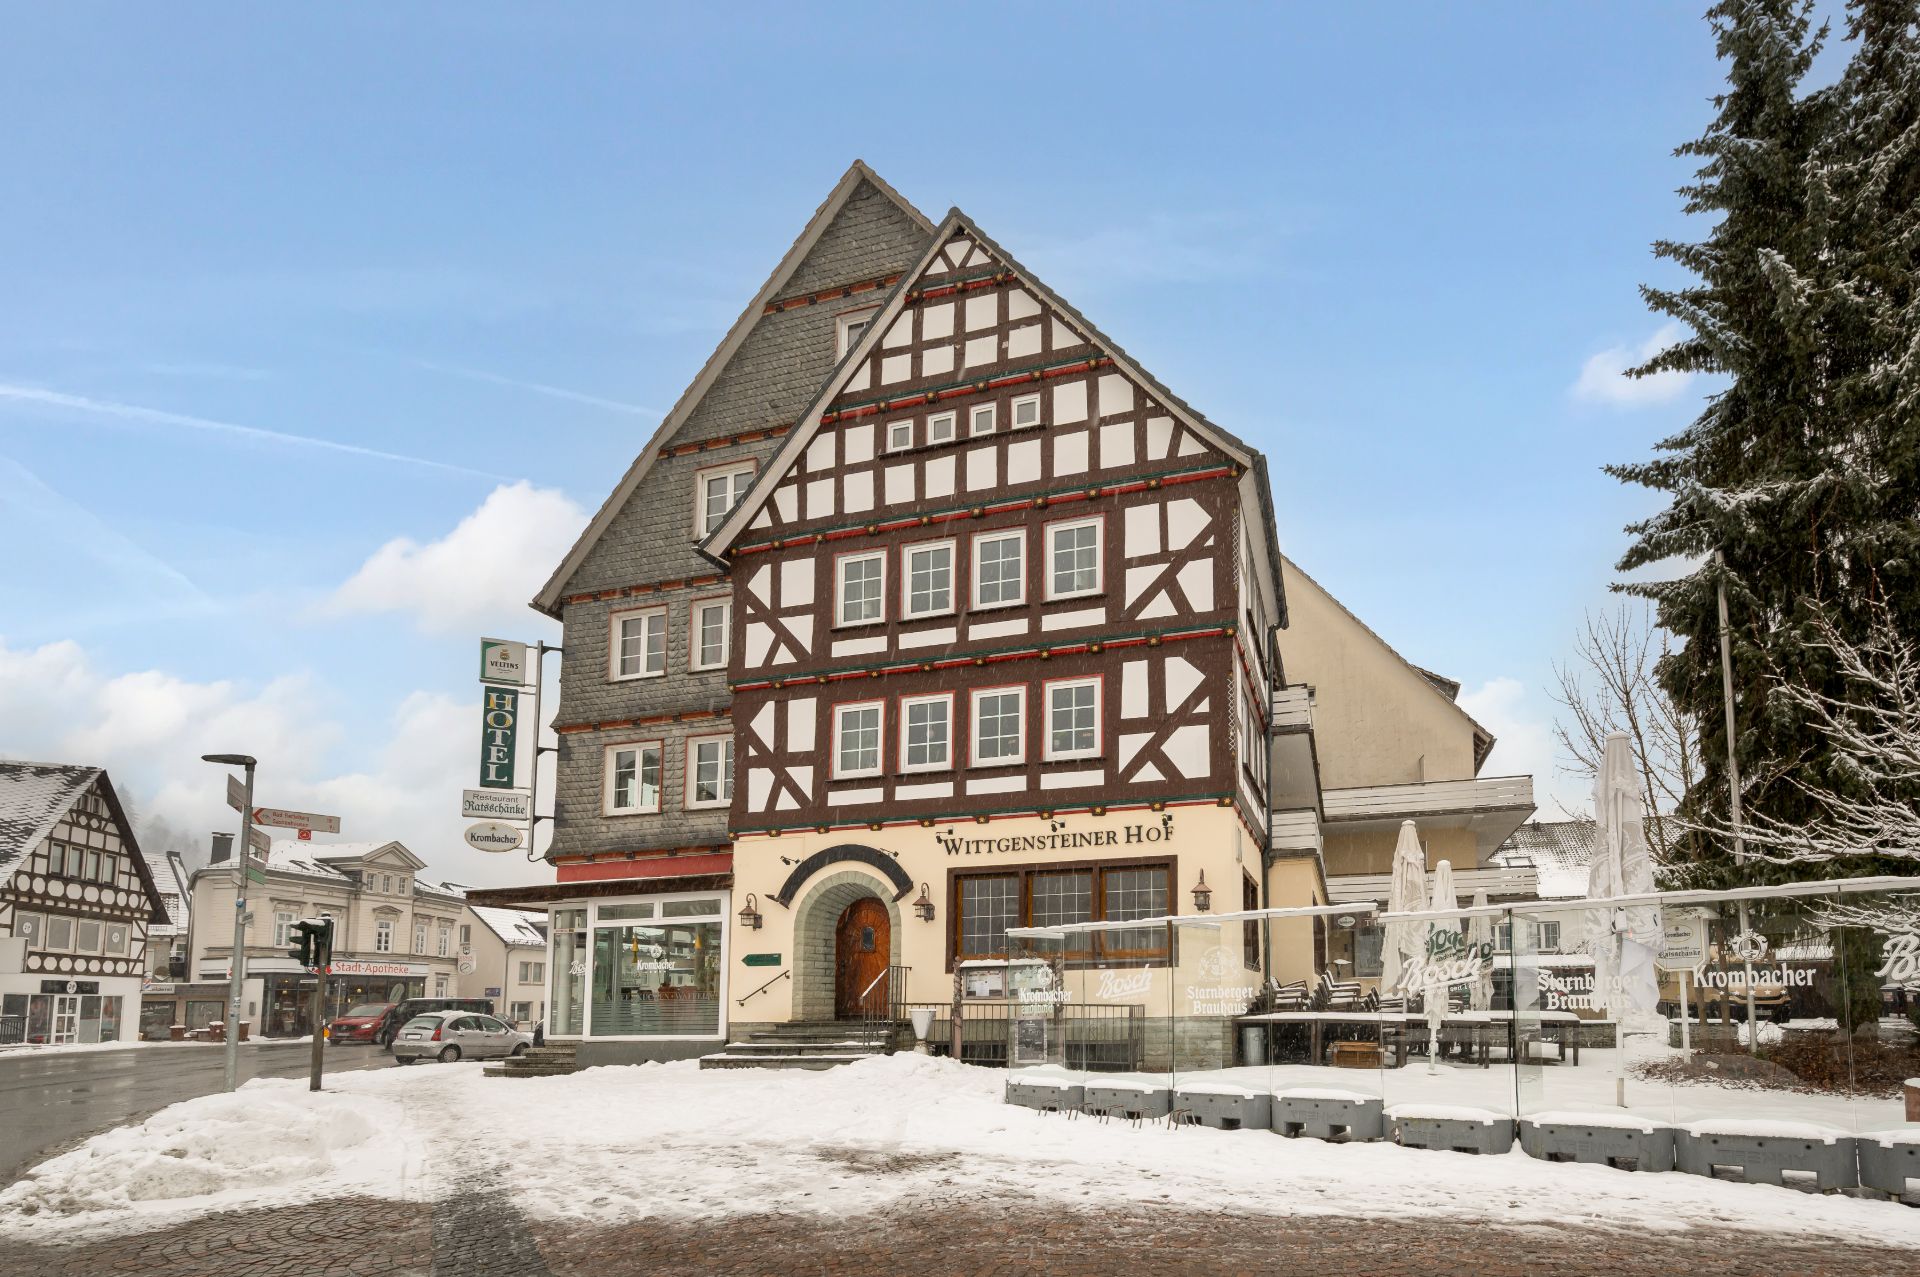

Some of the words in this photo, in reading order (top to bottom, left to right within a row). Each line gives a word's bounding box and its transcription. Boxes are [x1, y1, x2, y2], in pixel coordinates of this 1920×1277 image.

[490, 661, 519, 670] VELTINS
[486, 692, 515, 781] HOTEL
[472, 793, 519, 803] Restaurant
[464, 800, 526, 815] Ratsschänke
[470, 832, 518, 844] Krombacher
[943, 829, 1118, 856] WITTGENSTEINER
[335, 961, 409, 975] Stadt-Apotheke
[637, 959, 675, 971] Krombacher
[1397, 947, 1482, 999] Bosch
[1096, 963, 1152, 999] Bosch
[1693, 962, 1817, 988] Krombacher
[1019, 986, 1072, 1002] Krombacher
[1187, 985, 1253, 1001] Starnberger
[1193, 1000, 1248, 1016] Brauhaus
